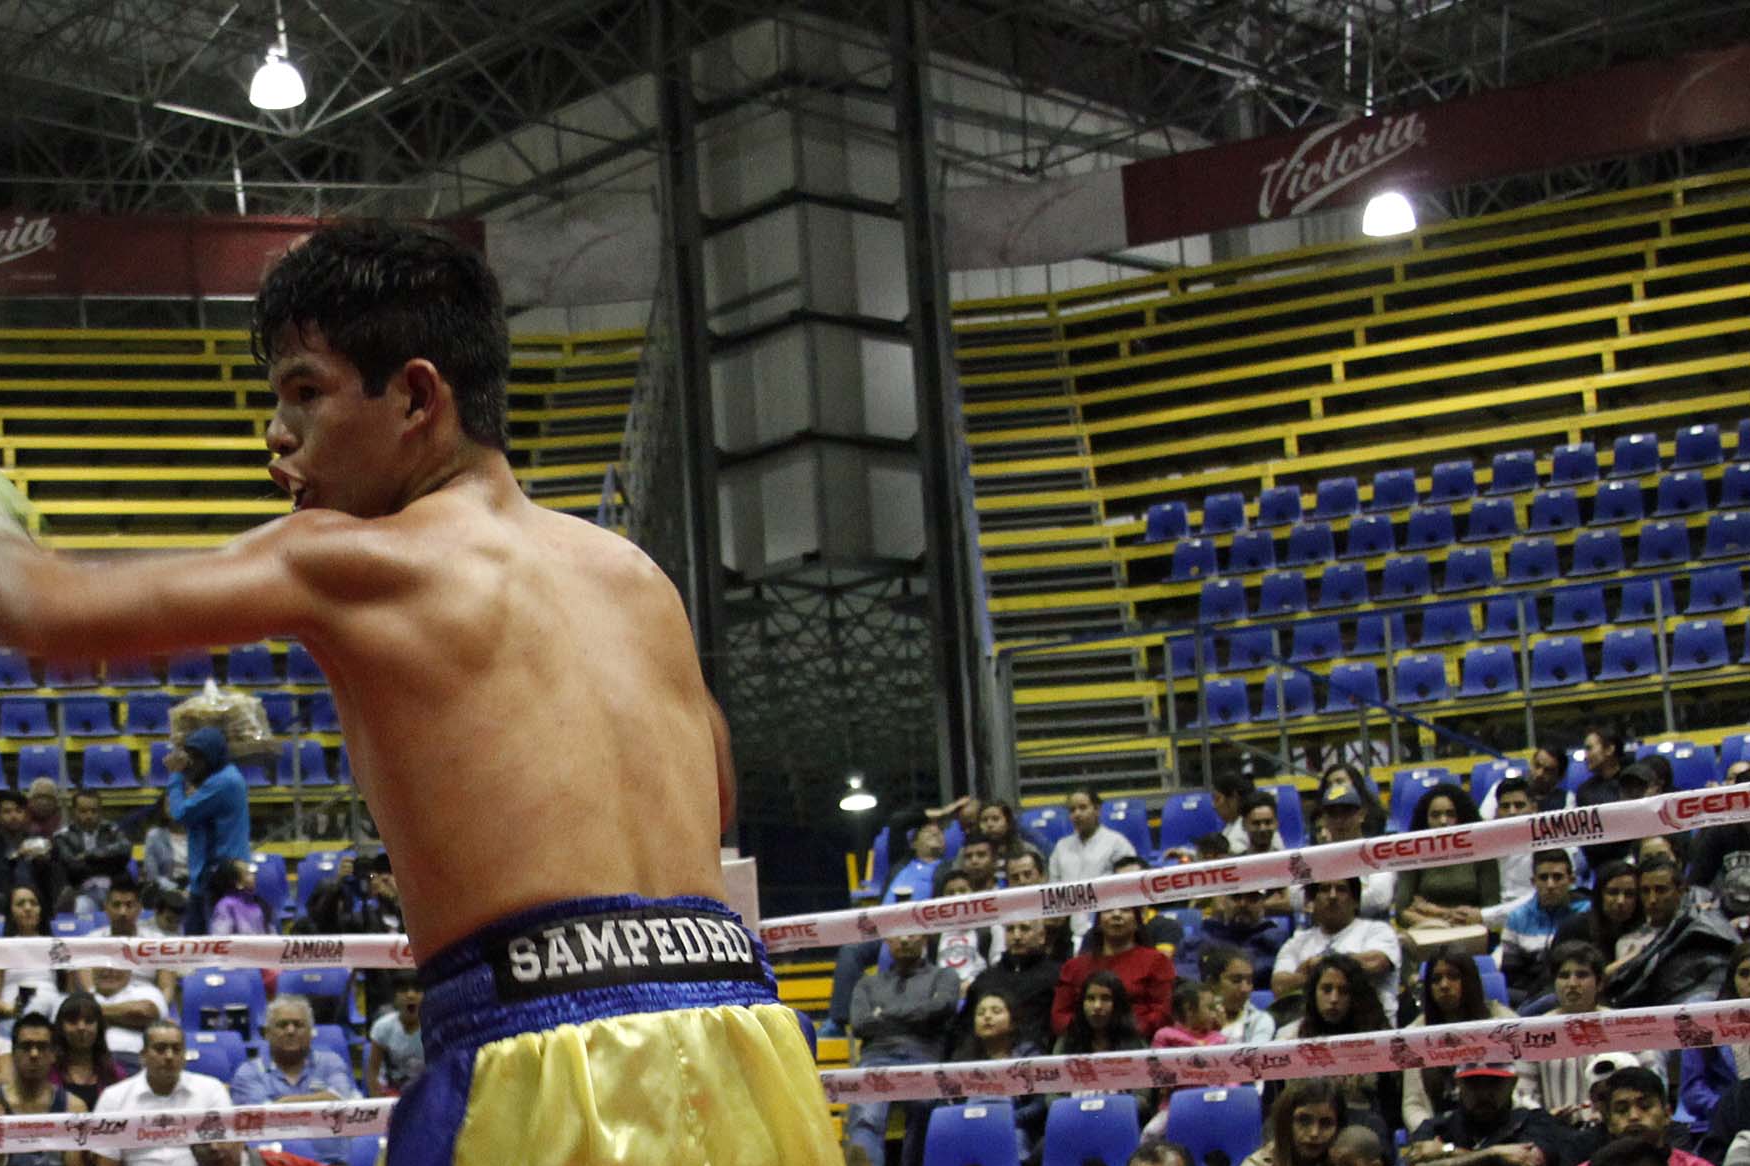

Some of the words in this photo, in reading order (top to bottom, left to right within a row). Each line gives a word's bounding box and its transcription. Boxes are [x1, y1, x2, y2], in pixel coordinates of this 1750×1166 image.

[1258, 112, 1428, 218] Victoria
[1529, 809, 1604, 841] ZAMORA
[1373, 831, 1473, 859] GENTE
[1151, 866, 1240, 893] GENTE
[922, 897, 999, 922] GENTE
[1040, 882, 1098, 910] ZAMORA
[137, 941, 233, 957] GENTE
[281, 939, 345, 960] ZAMORA
[508, 917, 753, 982] SAMPEDRO
